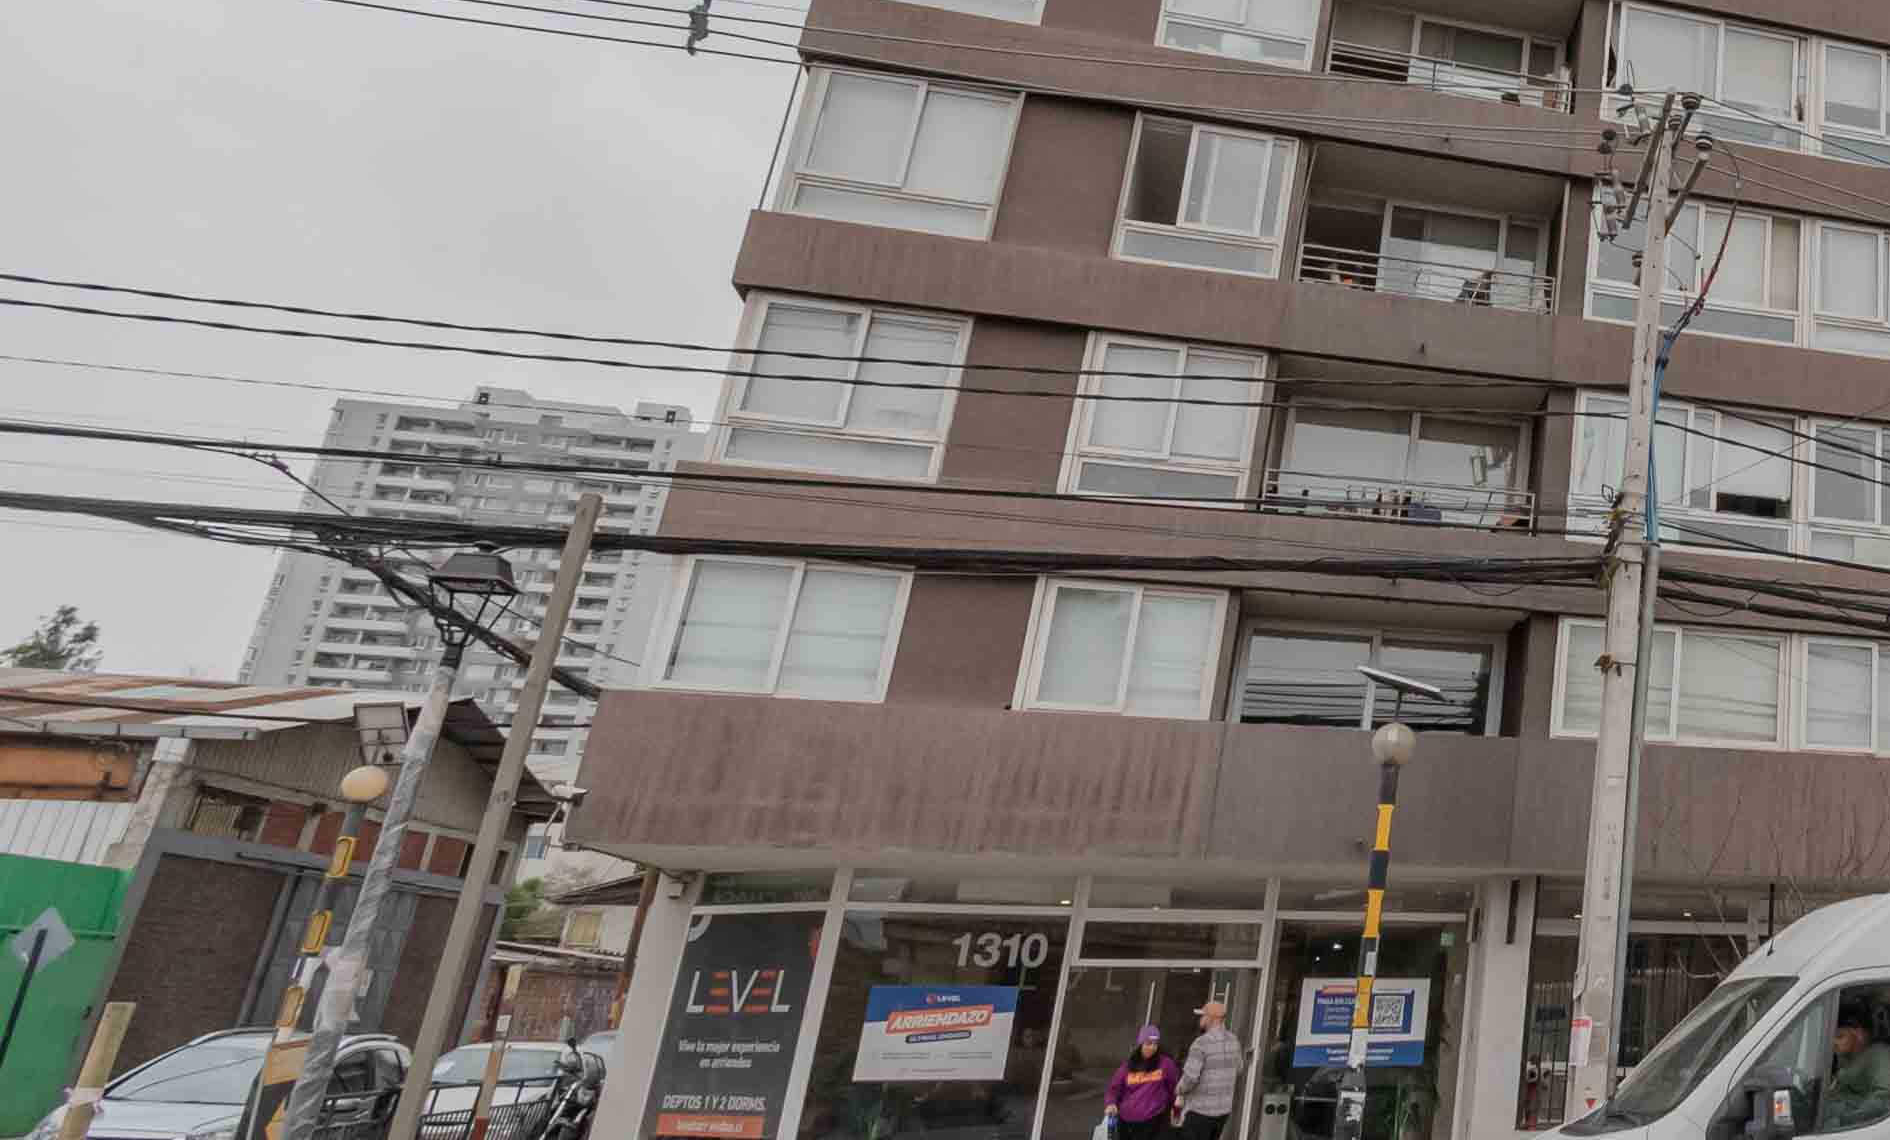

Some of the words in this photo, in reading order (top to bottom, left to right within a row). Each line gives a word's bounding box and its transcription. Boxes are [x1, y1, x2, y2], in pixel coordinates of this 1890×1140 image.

[952, 932, 1049, 969] 1310
[685, 969, 792, 1013] LEVEL
[890, 1009, 989, 1030] ARRIENDAZO
[662, 1094, 702, 1109] DEPTOS
[704, 1094, 712, 1109] 1
[711, 1095, 720, 1109] Y
[718, 1095, 728, 1109] 2
